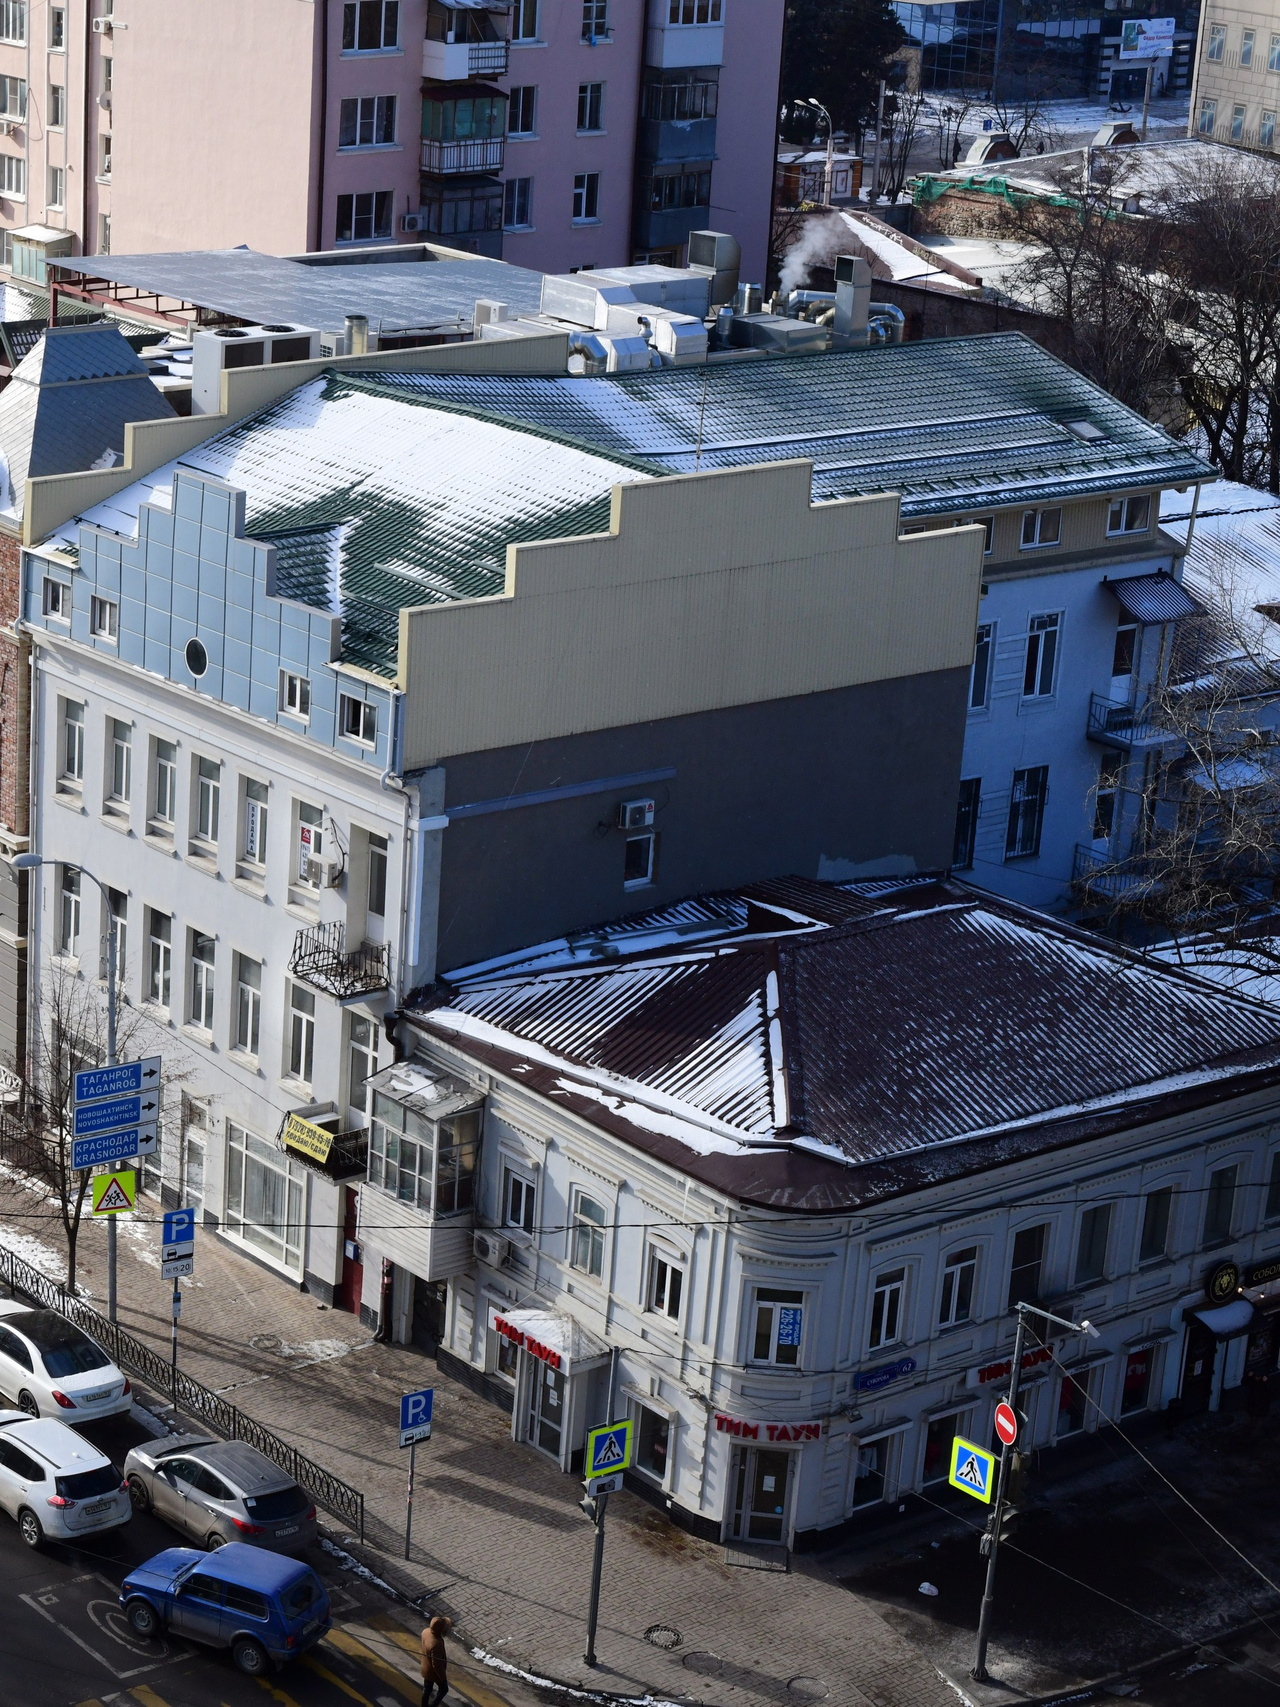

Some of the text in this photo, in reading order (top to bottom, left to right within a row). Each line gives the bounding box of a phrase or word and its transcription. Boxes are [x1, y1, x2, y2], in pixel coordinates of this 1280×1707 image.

[82, 1068, 134, 1086] ТАГАНРОГ
[82, 1078, 136, 1096] TAGANROG
[77, 1111, 138, 1128] NOVOSHAKHTINSK
[78, 1103, 134, 1120] НОВОШАХТИНСК
[76, 1133, 136, 1154] КРАСНОДАР
[76, 1143, 136, 1164] KRASNODAR
[180, 1263, 190, 1272] 20
[494, 1315, 561, 1369] ТИМ ТАУН
[1021, 1346, 1053, 1369] АУН
[715, 1413, 820, 1441] ТИМ ТАУН
